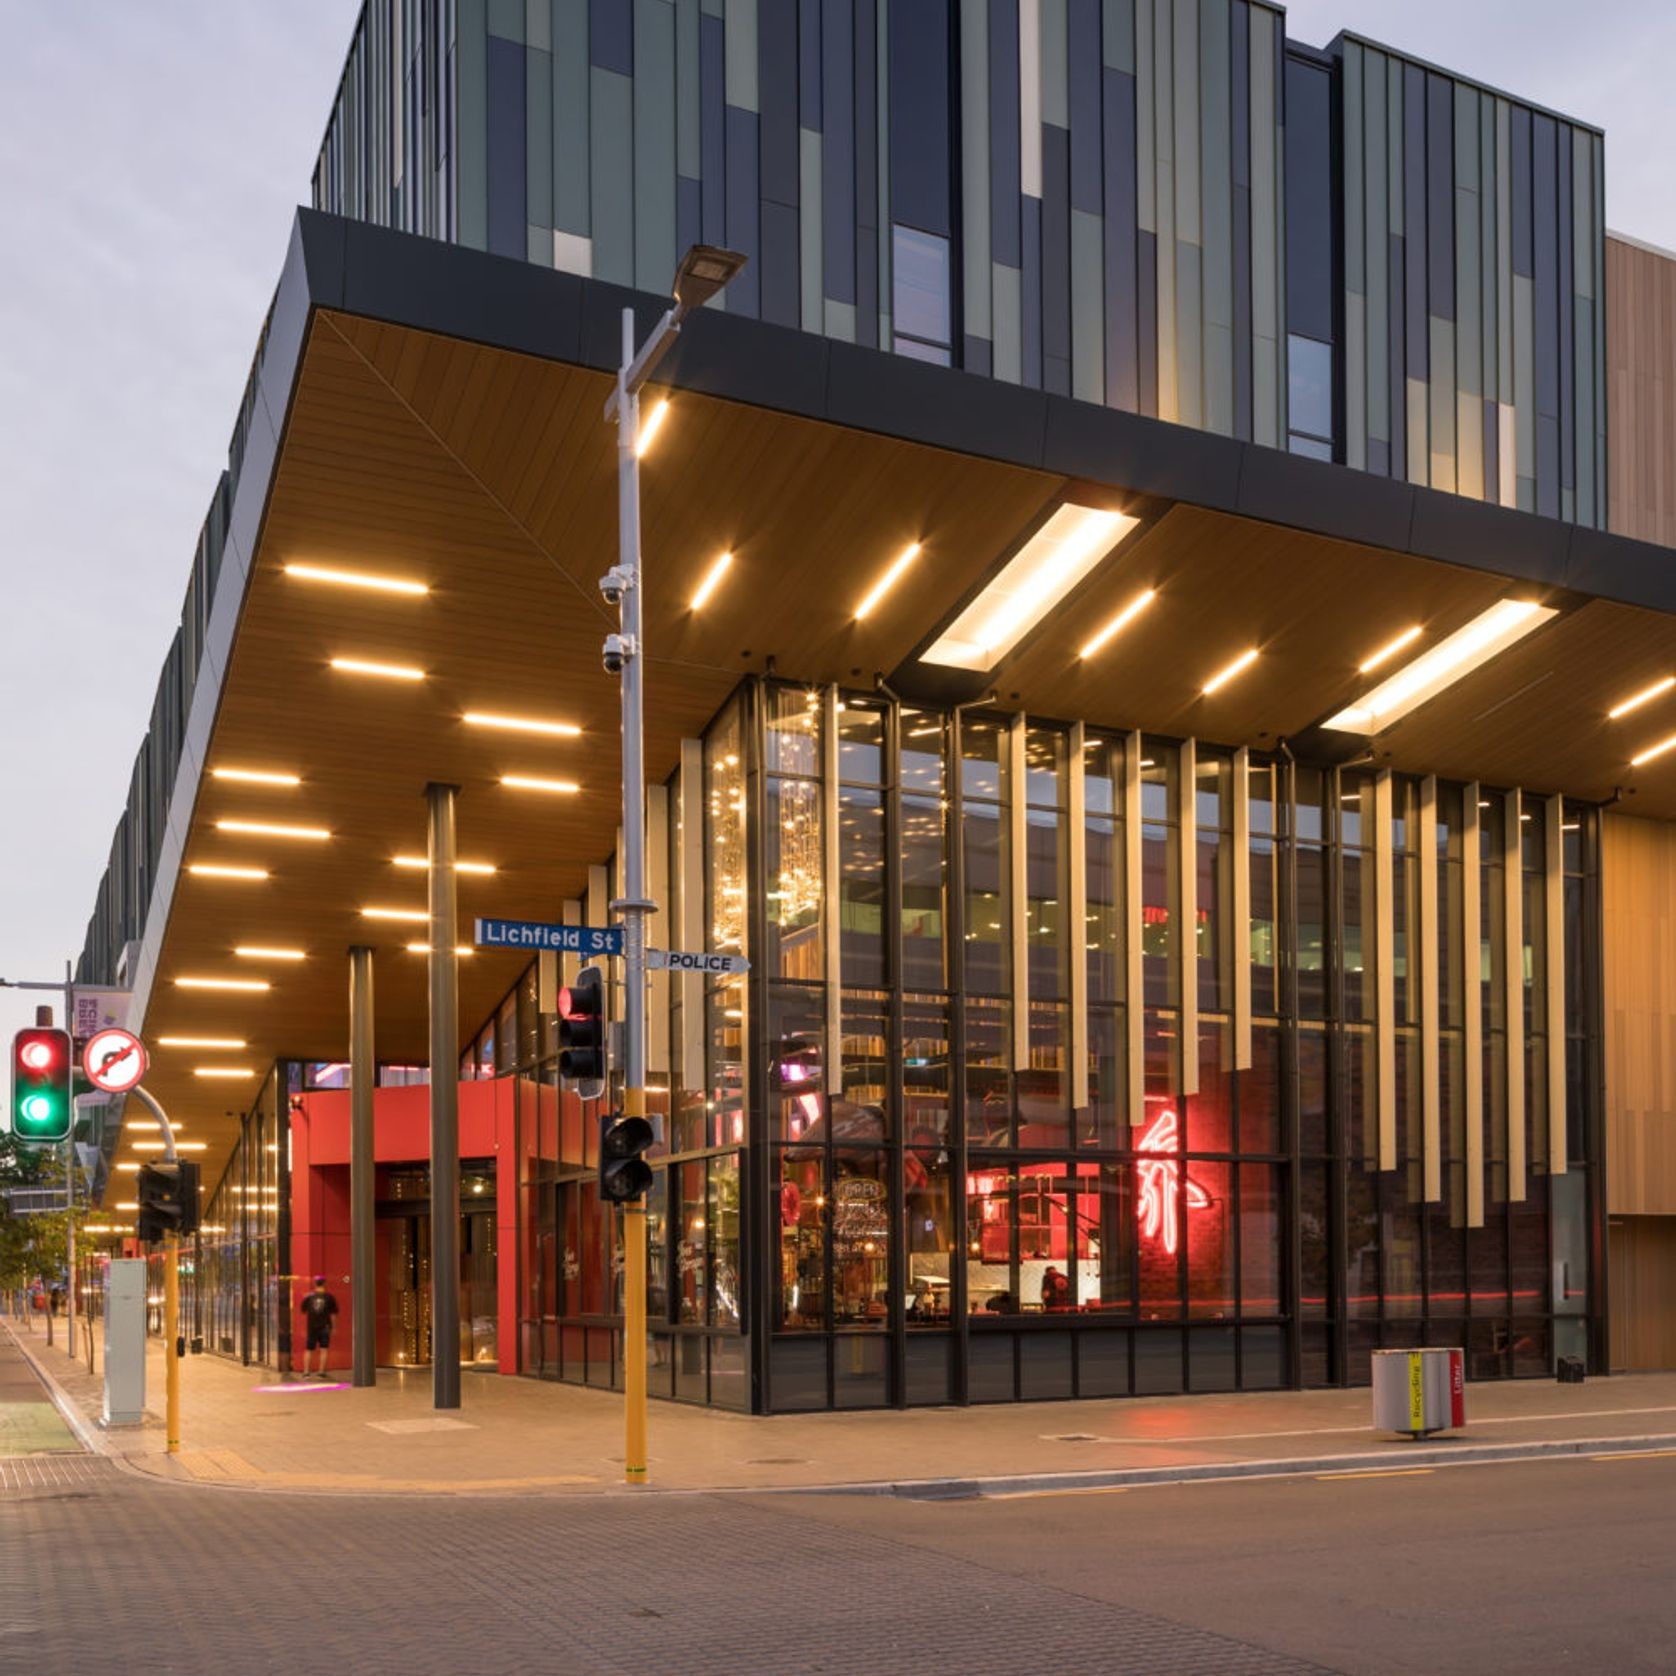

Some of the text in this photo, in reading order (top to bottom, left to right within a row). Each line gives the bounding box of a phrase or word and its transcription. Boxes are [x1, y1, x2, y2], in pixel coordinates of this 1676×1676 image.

[487, 923, 614, 950] Lichfield St
[669, 954, 732, 971] POLICE
